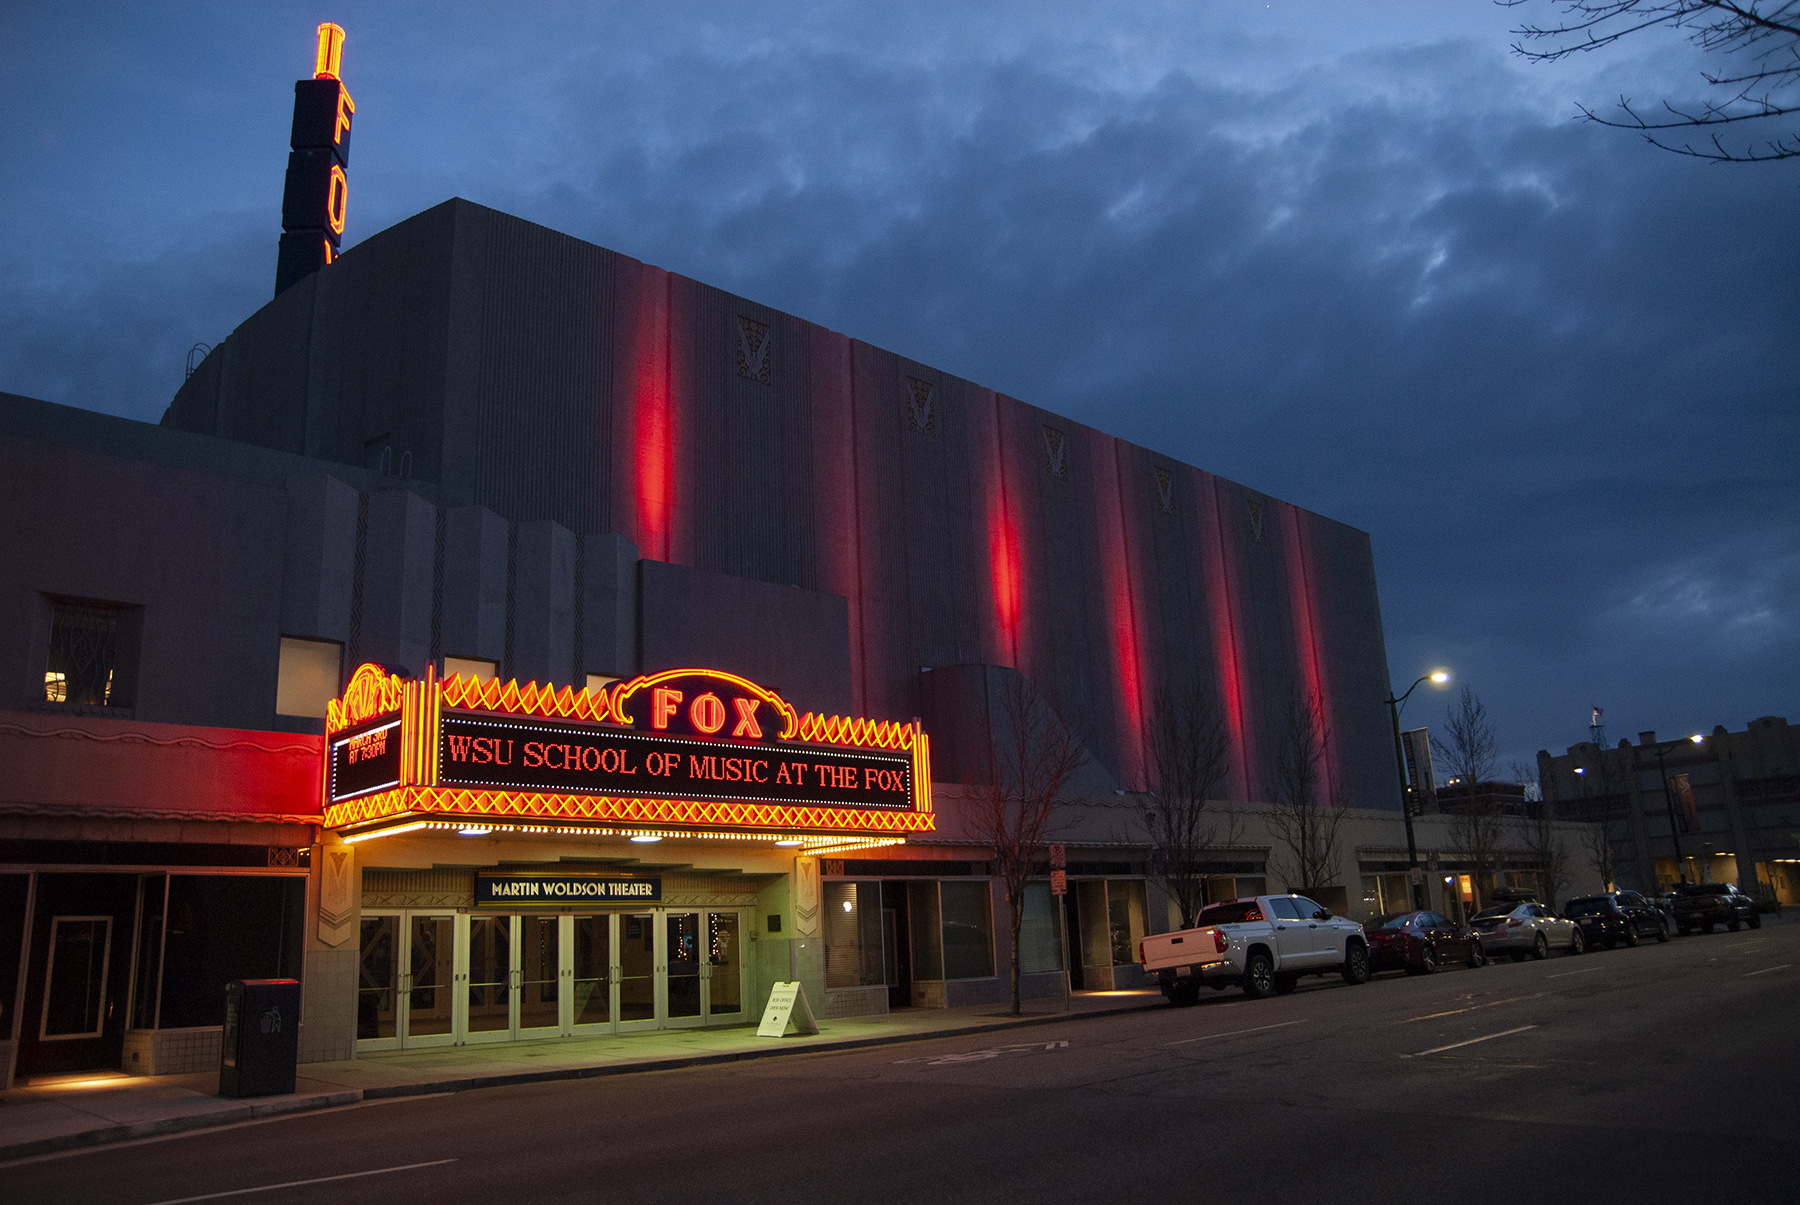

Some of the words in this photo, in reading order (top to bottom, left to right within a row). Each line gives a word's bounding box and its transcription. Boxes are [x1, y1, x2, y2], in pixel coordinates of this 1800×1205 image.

[652, 687, 763, 738] FOX
[348, 749, 359, 765] AT
[448, 735, 514, 765] WSU
[523, 741, 637, 775] SCHOOL
[646, 751, 682, 777] OF
[689, 755, 768, 783] MUSIC
[776, 762, 808, 786] AT
[814, 764, 858, 789] THE
[864, 768, 905, 792] FOX
[492, 882, 539, 896] MARTIN
[543, 882, 606, 896] WOLDSON
[608, 882, 653, 896] THEATER
